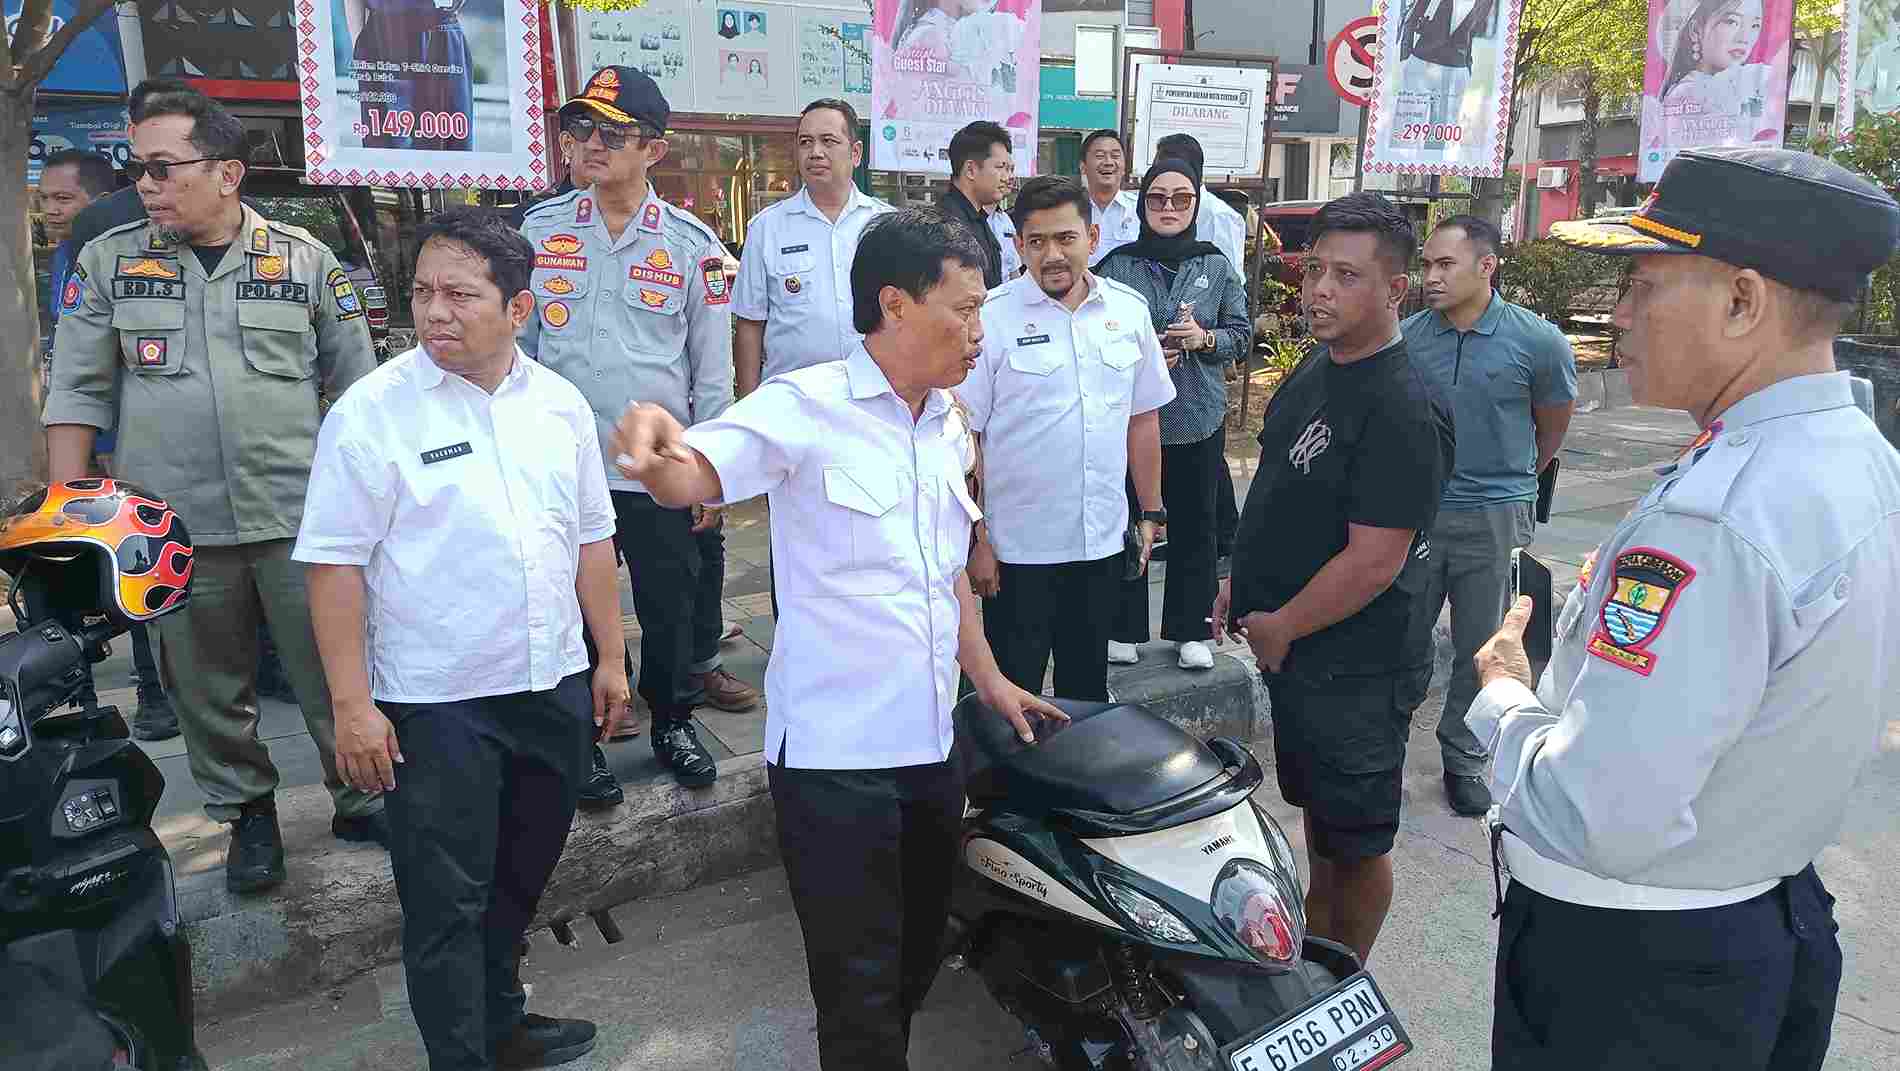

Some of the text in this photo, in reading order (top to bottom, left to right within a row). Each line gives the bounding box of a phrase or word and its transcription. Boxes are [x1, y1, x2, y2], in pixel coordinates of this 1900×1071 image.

[894, 56, 947, 73] Guest Star
[536, 256, 585, 268] GUNAWAN
[632, 268, 680, 286] DISHUB
[1264, 1020, 1328, 1071] 6766
[1327, 989, 1378, 1034] PBN
